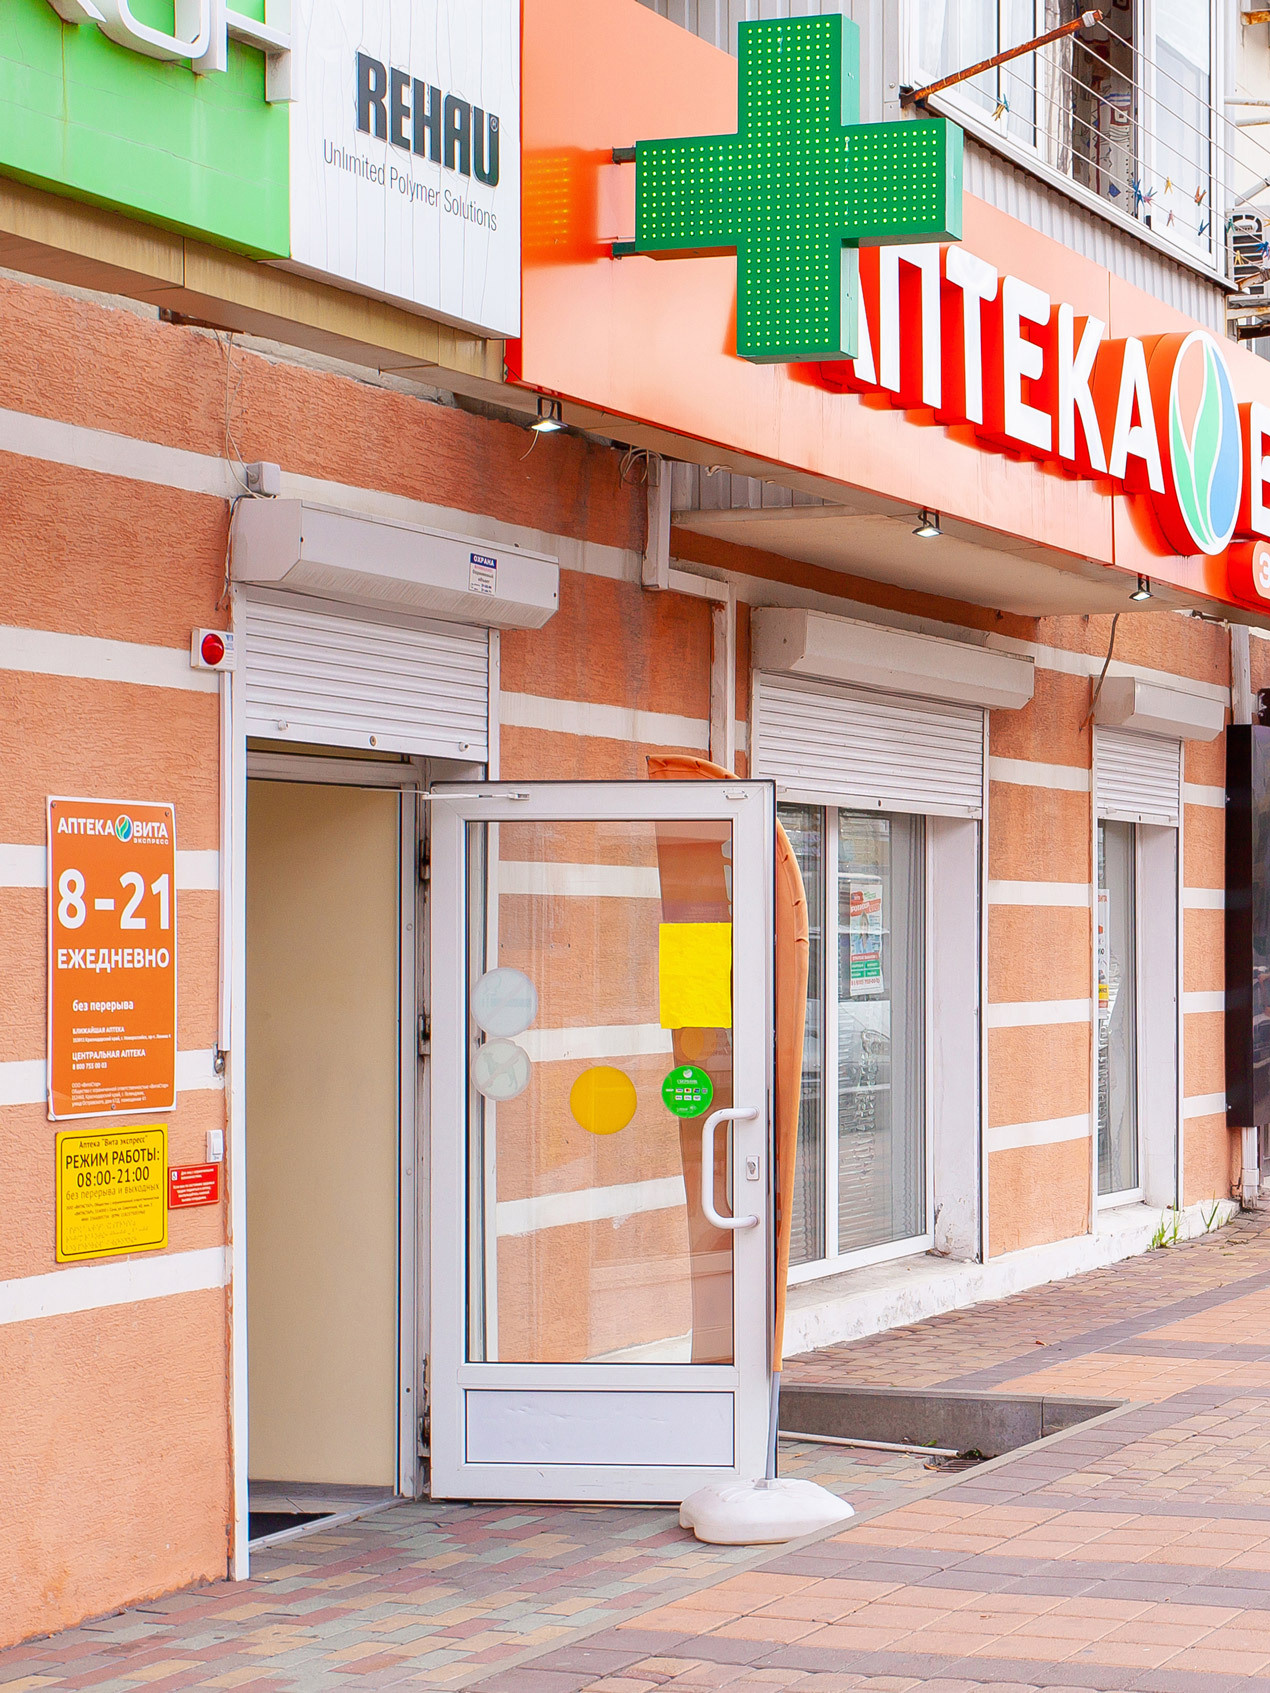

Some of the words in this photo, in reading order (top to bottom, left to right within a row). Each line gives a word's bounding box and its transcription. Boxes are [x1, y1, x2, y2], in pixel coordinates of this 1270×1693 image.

[323, 138, 386, 187] Unlimited
[390, 166, 441, 209] Polymer
[444, 189, 498, 231] Solutions
[57, 817, 115, 836] АПТЕКА
[133, 822, 168, 838] ВИТА
[57, 947, 170, 973] ЕЖЕДНЕВНО
[72, 1000, 88, 1011] без
[90, 1000, 134, 1012] перерыва
[72, 1050, 120, 1061] ЦЕНТРАЛЬНАЯ
[121, 1049, 146, 1058] АПТЕКА
[79, 1140, 100, 1149] Аптека
[66, 1152, 108, 1169] РЕЖИМ
[112, 1147, 160, 1165] РАБОТЫ:
[77, 1166, 150, 1188] 08:00-21:00
[66, 1190, 79, 1201] без
[81, 1187, 116, 1200] перерыва
[124, 1184, 160, 1195] выходных
